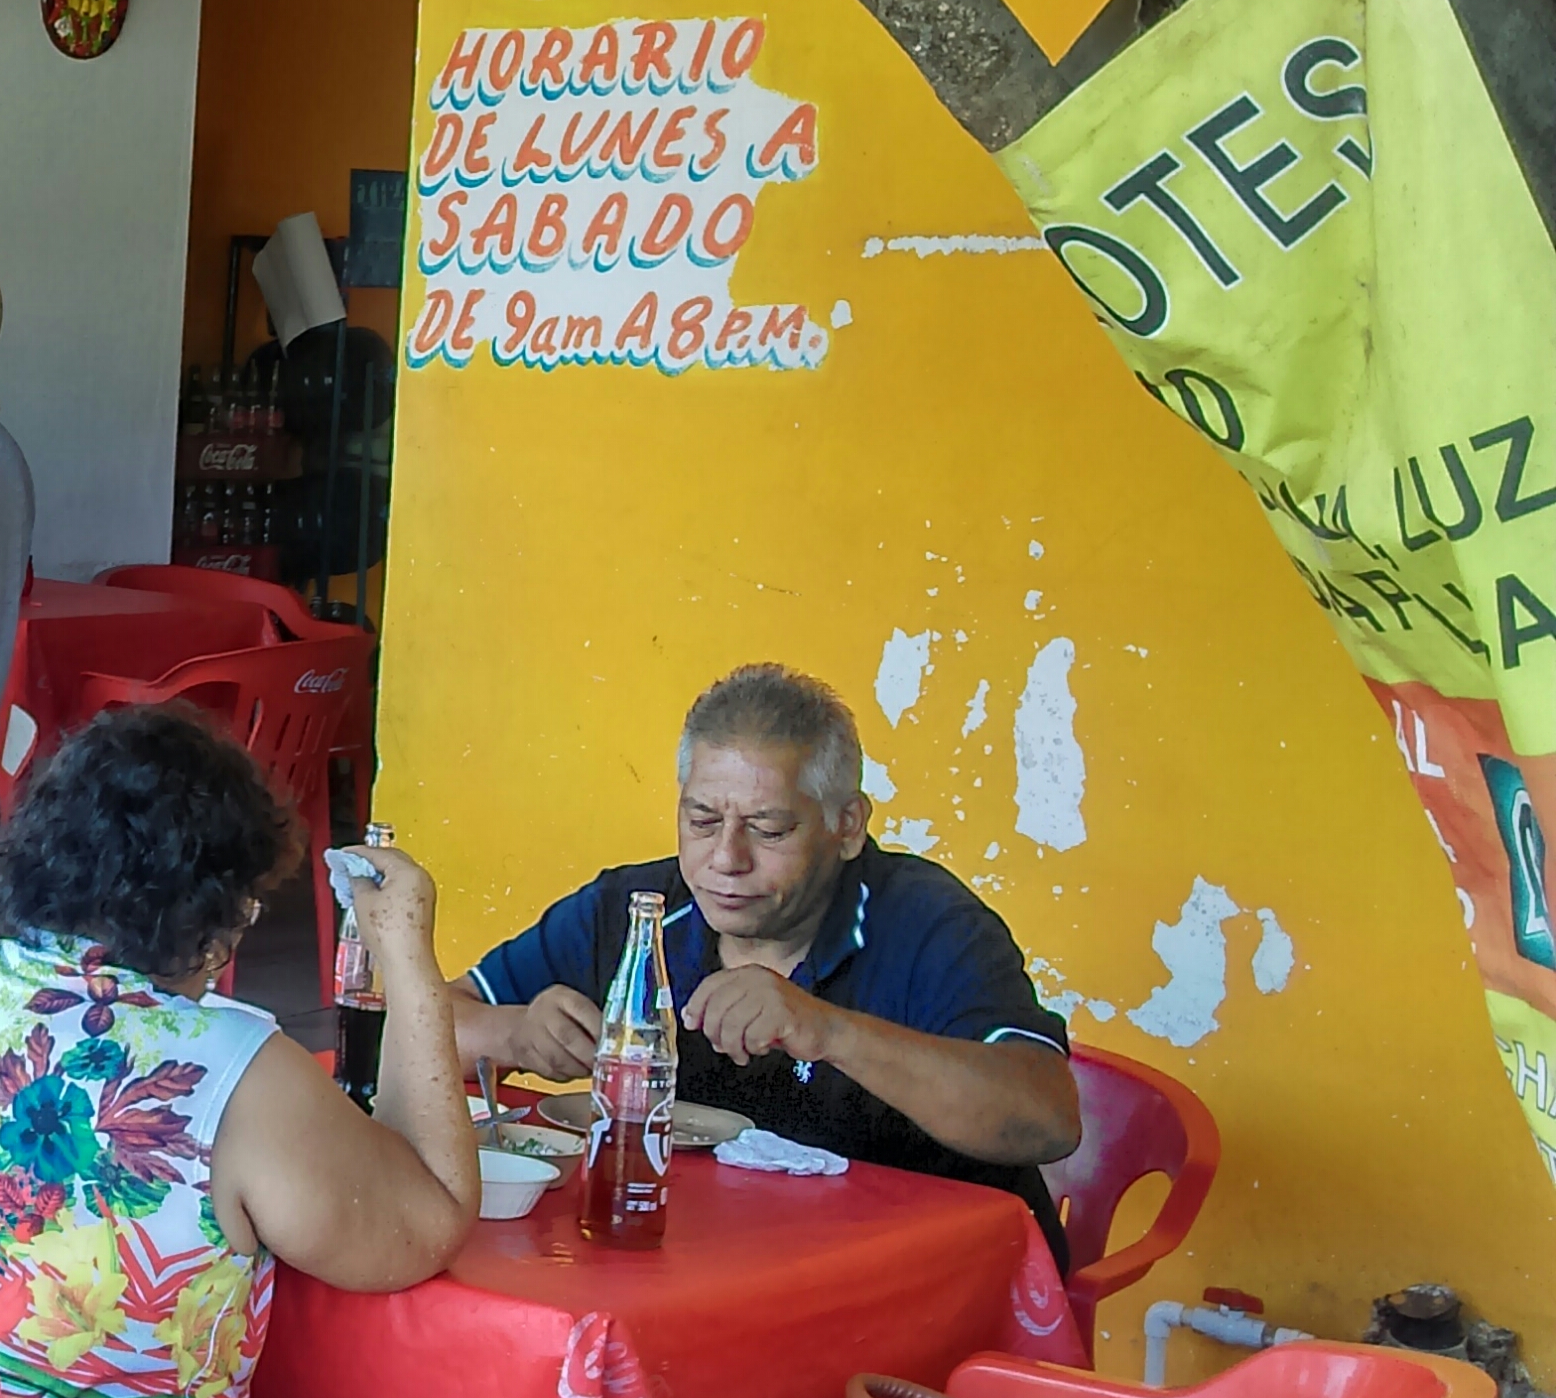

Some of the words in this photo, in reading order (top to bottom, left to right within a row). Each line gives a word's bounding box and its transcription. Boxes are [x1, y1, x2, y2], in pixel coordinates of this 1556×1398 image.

[430, 18, 766, 110] HORARIO
[417, 111, 498, 196] DE
[502, 105, 731, 187] LUNES
[746, 103, 819, 180] A
[418, 191, 754, 275] SABADO
[406, 289, 486, 369] DE
